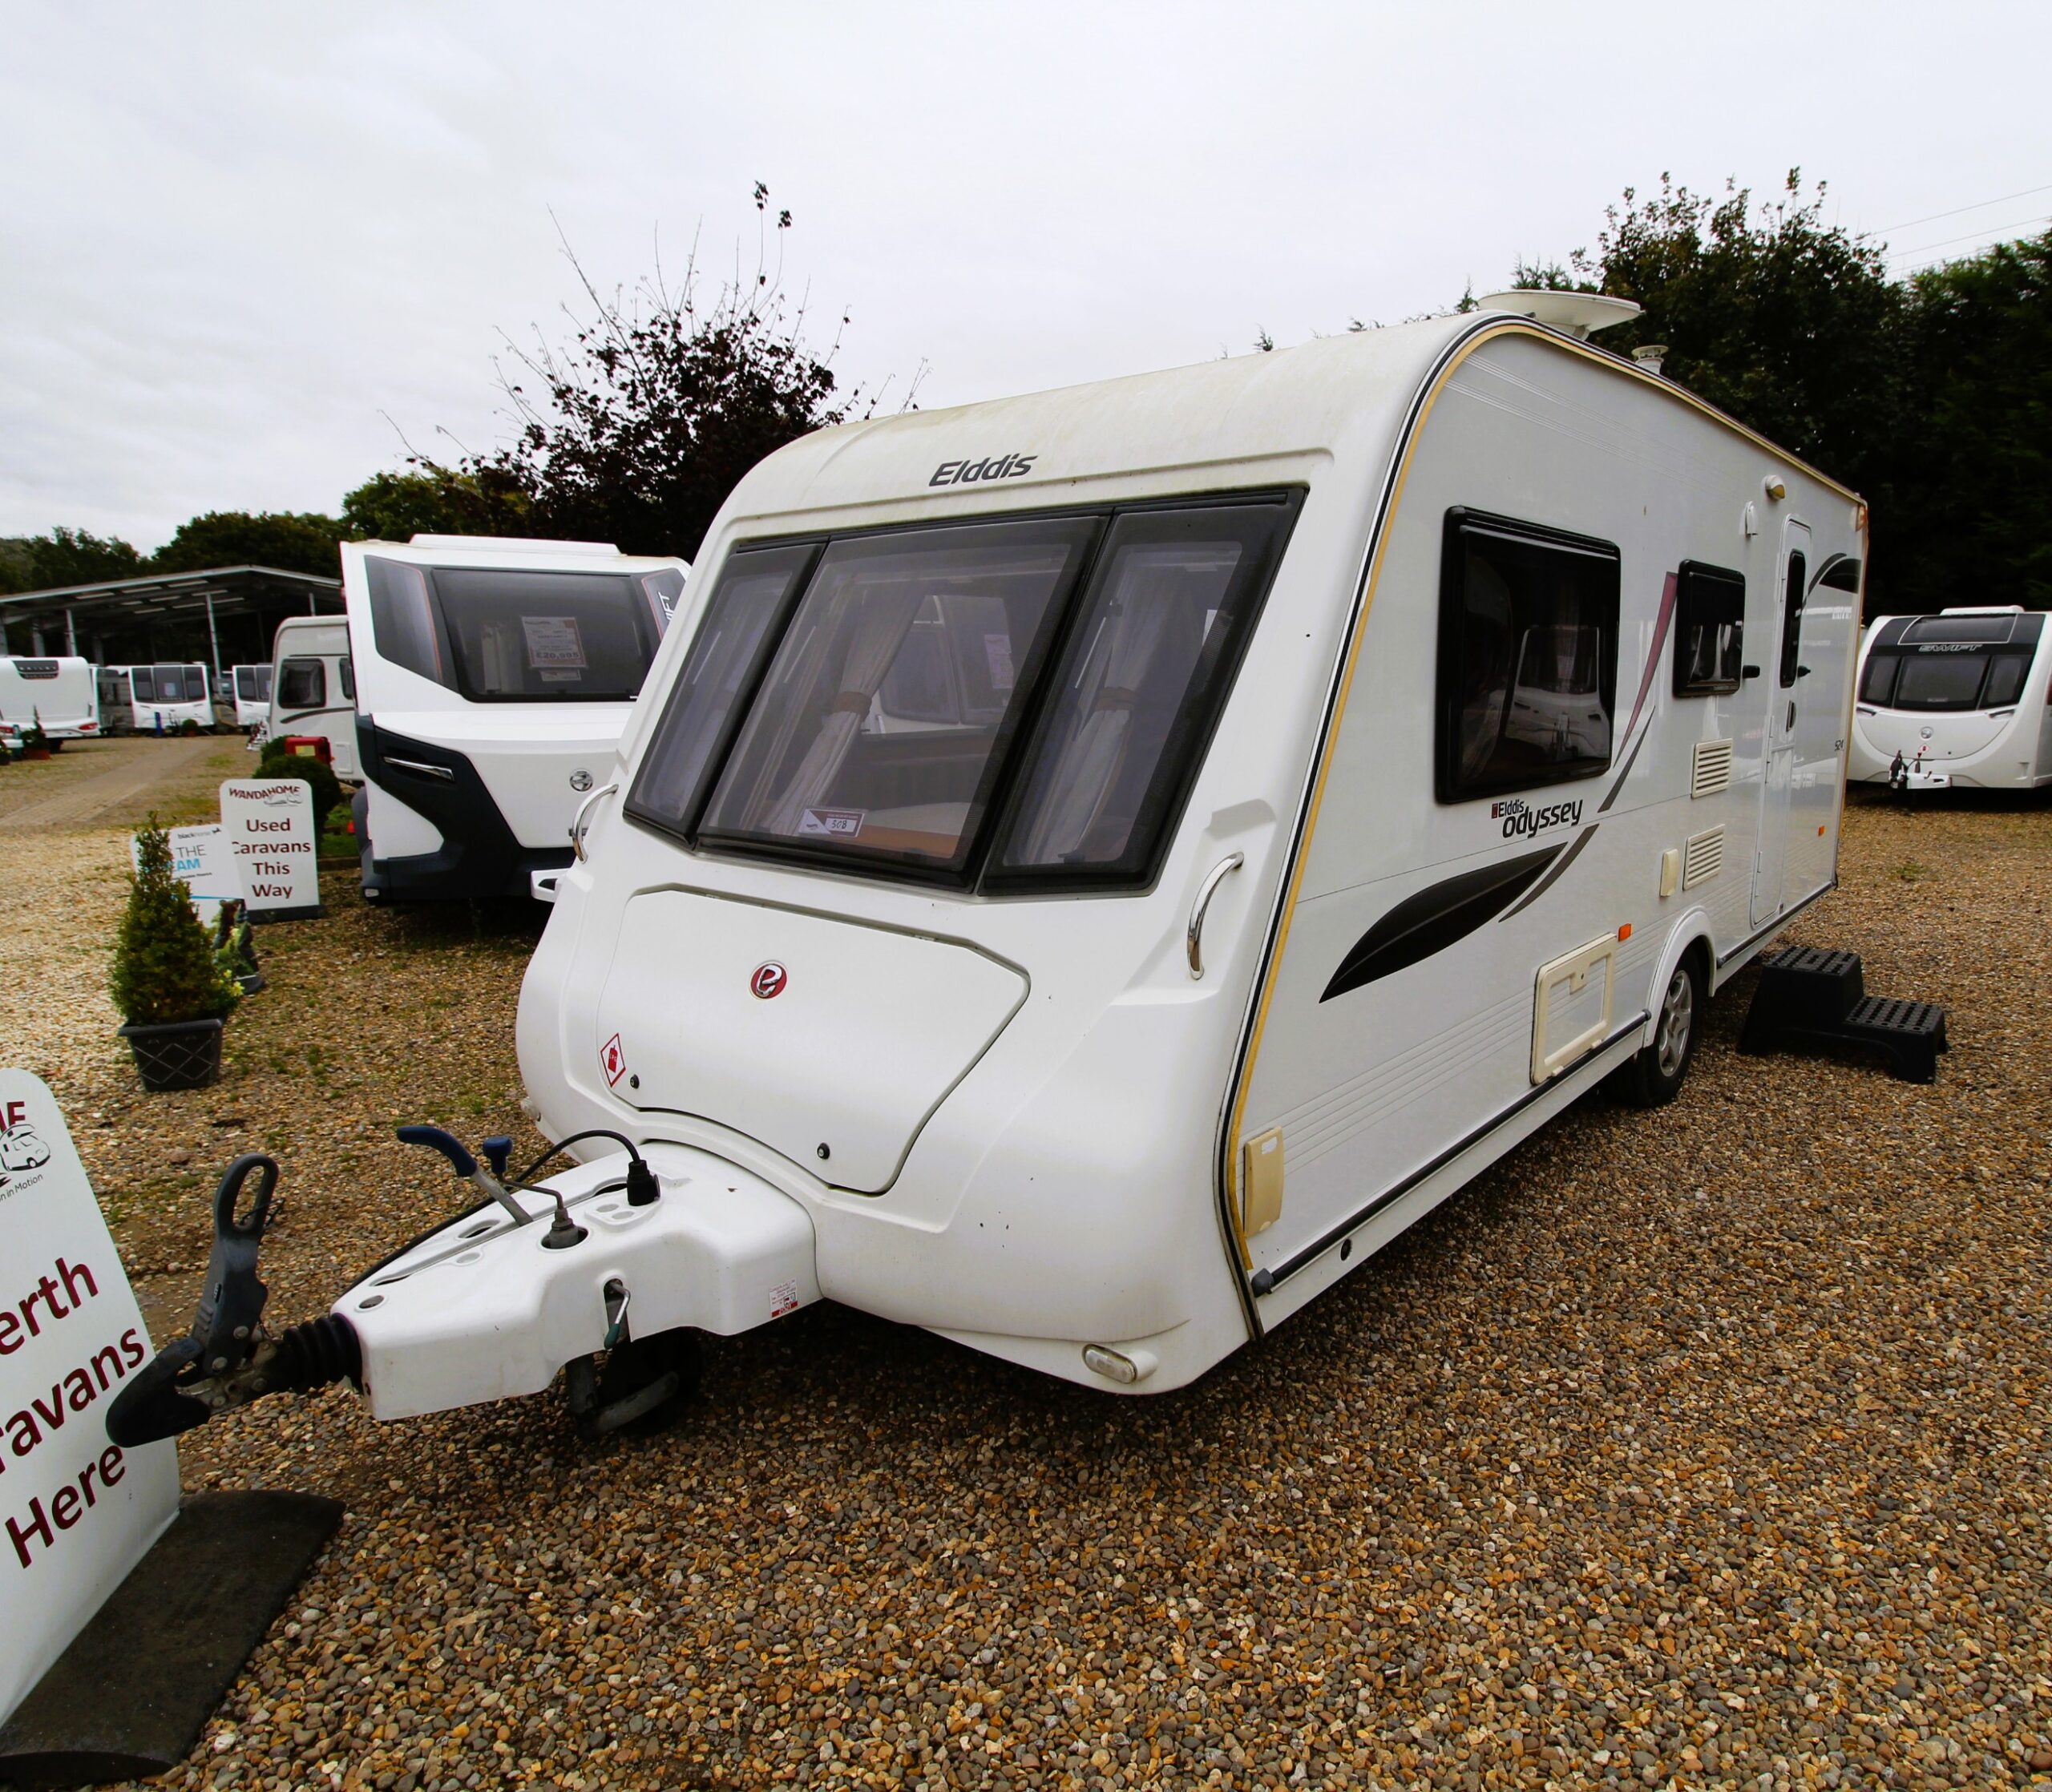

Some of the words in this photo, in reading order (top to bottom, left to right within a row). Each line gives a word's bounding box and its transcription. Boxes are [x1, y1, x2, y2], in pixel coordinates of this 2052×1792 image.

[928, 453, 1039, 487] Elddis
[1499, 799, 1525, 817] Elddis
[246, 818, 290, 832] Used
[1502, 799, 1584, 839] odyssey
[176, 844, 207, 858] THE
[252, 861, 290, 875] This
[252, 884, 293, 899] Way
[6, 1189, 14, 1198] in
[14, 1174, 43, 1193] Motion
[0, 1257, 99, 1355] erth
[6, 1444, 126, 1570] Here
